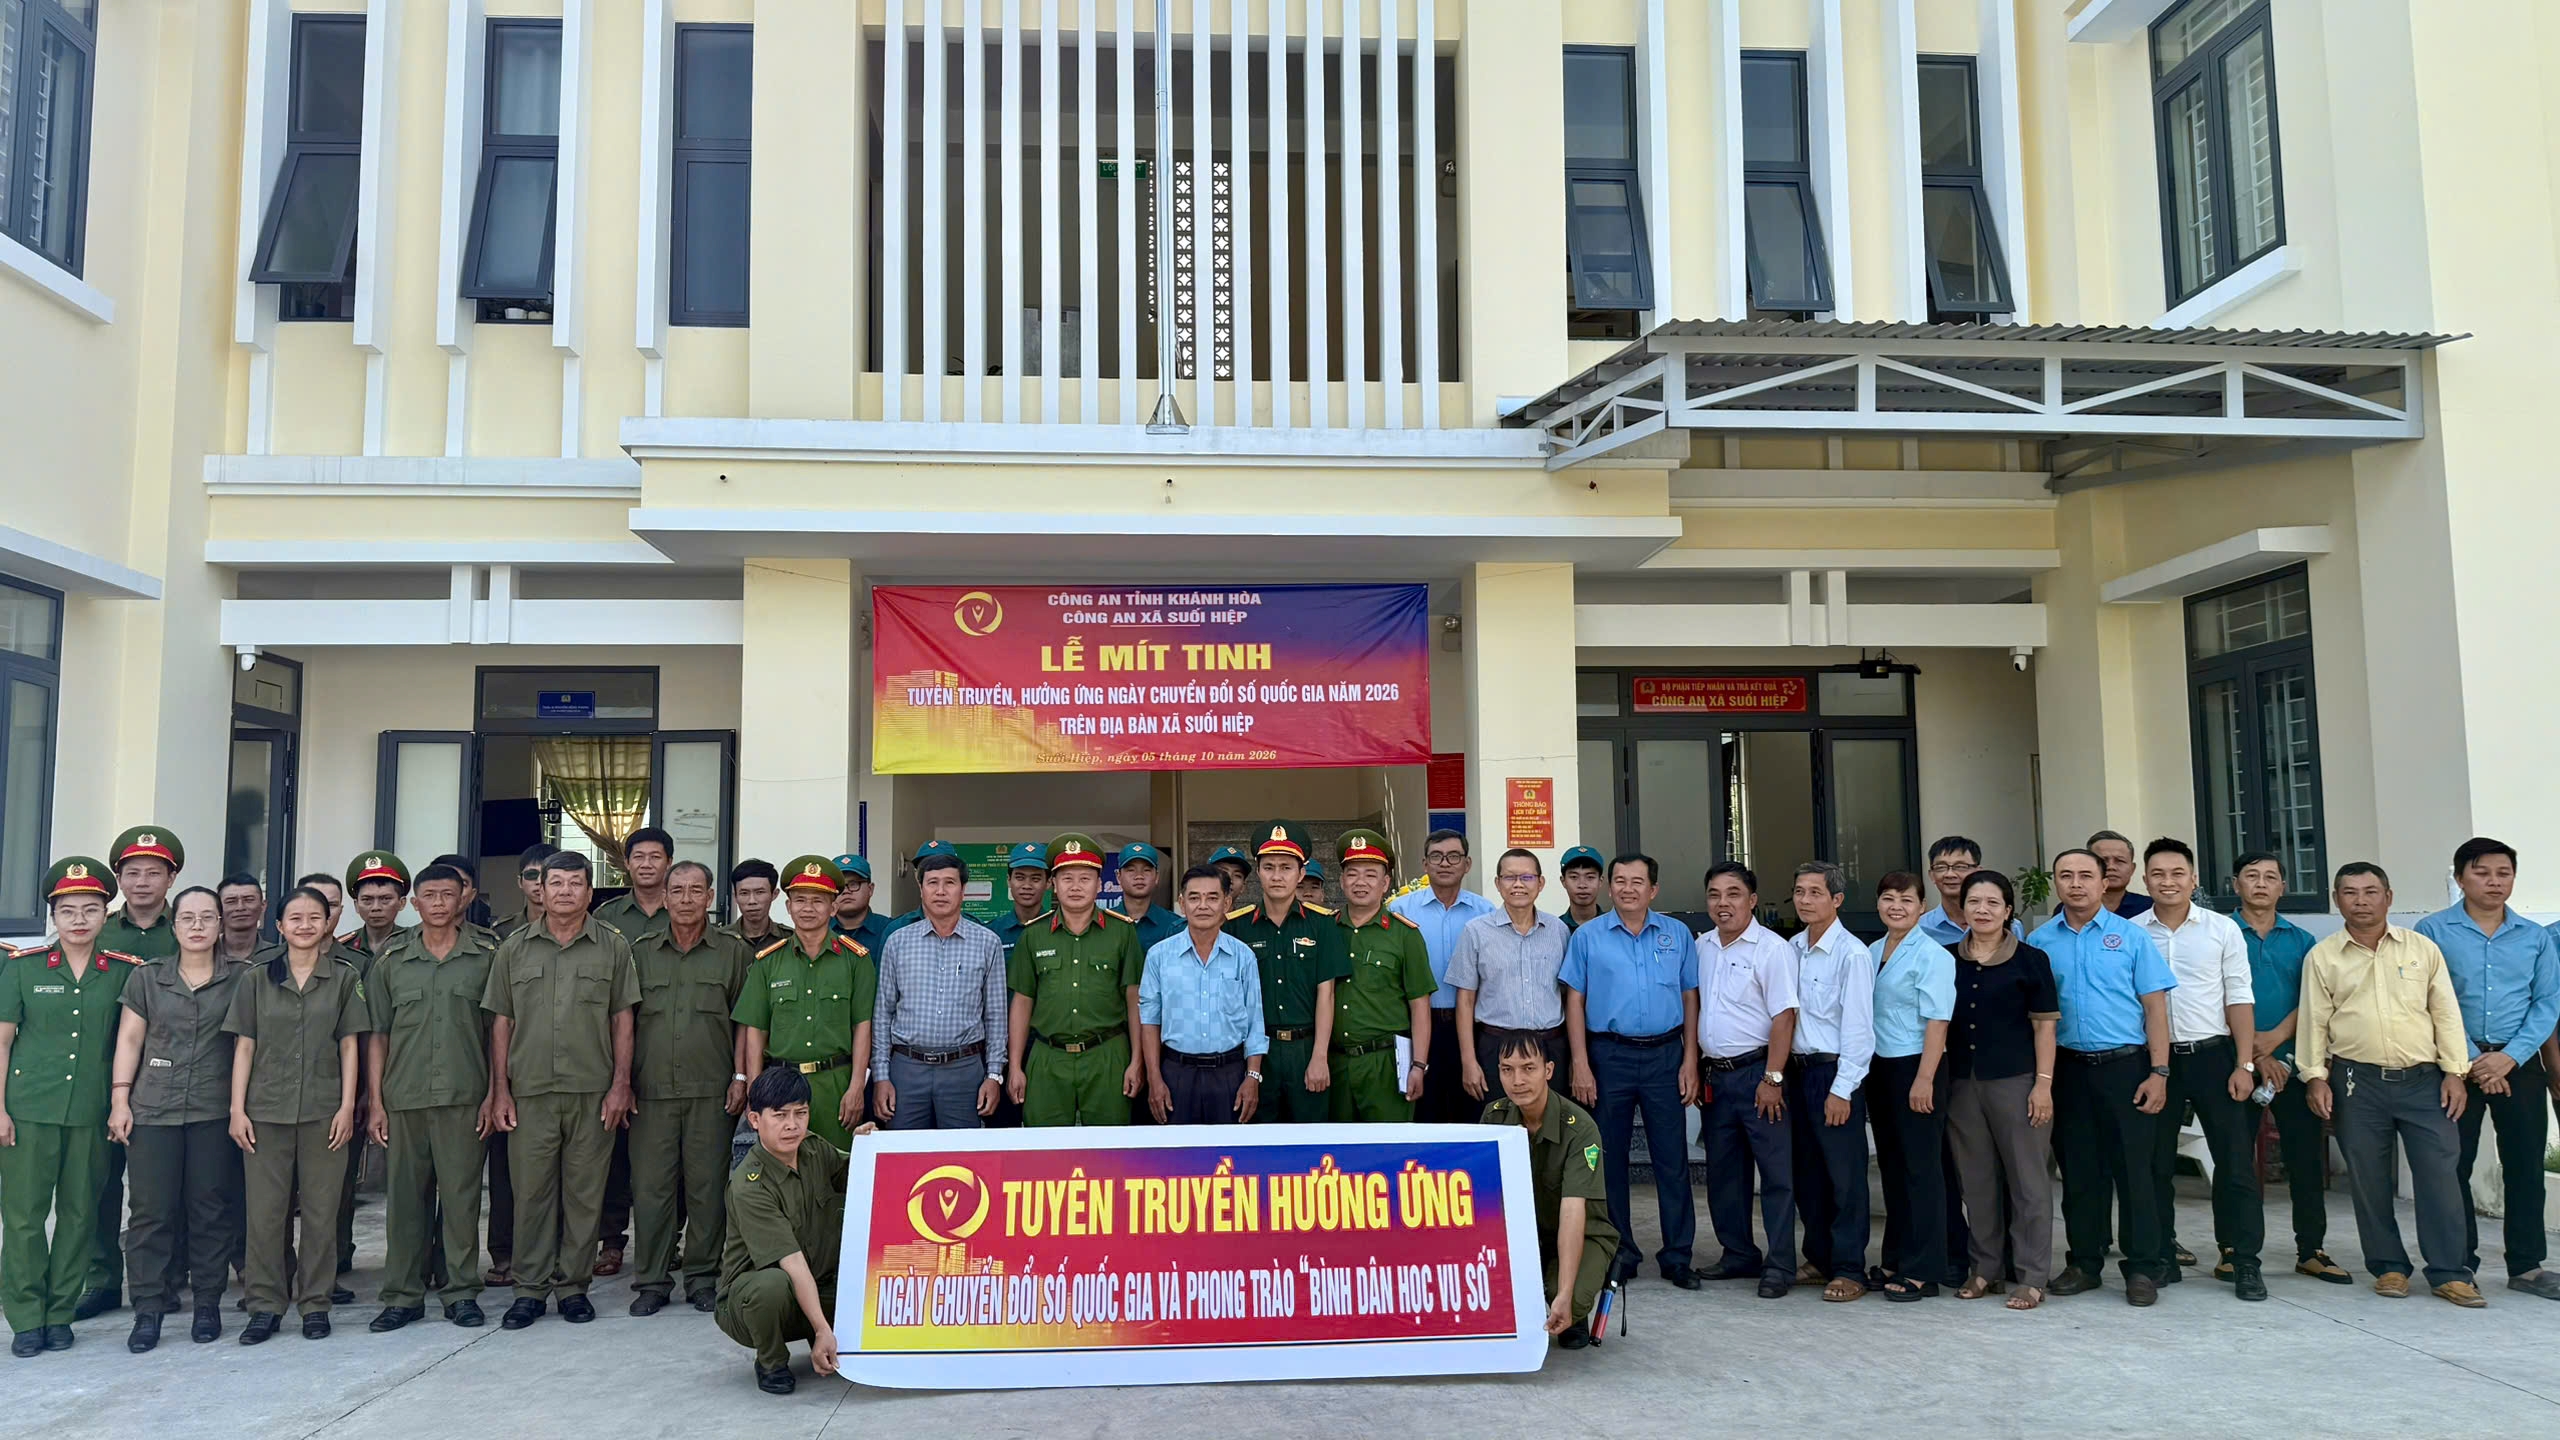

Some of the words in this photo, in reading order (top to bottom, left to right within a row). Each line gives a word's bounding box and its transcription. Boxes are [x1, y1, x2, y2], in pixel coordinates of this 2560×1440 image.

[1048, 592, 1095, 606] CÔNG
[1098, 594, 1121, 606] AN
[1125, 590, 1163, 605] TỈNH
[1168, 592, 1225, 605] KHÁNH
[1229, 590, 1262, 604] HÒA
[1063, 610, 1108, 624] CÔNG
[1113, 612, 1136, 624] AN
[1141, 610, 1163, 624] XÃ
[1168, 608, 1206, 624] SUỐI
[1211, 610, 1248, 625] HIỆP
[1041, 636, 1085, 672] LỄ
[1099, 639, 1170, 671] MÍT
[1182, 643, 1272, 671] TINH
[908, 684, 953, 706] TUYÊN
[958, 682, 1017, 707] TRUYỀN,
[1021, 682, 1070, 705] HƯỞNG
[1074, 684, 1104, 705] ỨNG
[1108, 682, 1146, 704] NGÀY
[1150, 679, 1206, 704] CHUYỂN
[1209, 678, 1234, 704] ĐỔI
[1237, 679, 1257, 704] SỐ
[1260, 678, 1298, 704] QUỐC
[1301, 684, 1325, 702] GIA
[1328, 681, 1361, 702] NĂM
[1365, 684, 1399, 701] 2026
[1652, 694, 1685, 706] CÔNG
[1688, 696, 1706, 706] AN
[1709, 694, 1726, 706] XÃ
[1729, 692, 1757, 706] SUỐI
[1761, 694, 1788, 709] HIỆP
[1060, 714, 1096, 734] TRÊN
[1100, 717, 1124, 738] ĐỊA
[1128, 712, 1158, 734] BÀN
[1162, 713, 1182, 734] XÃ
[1185, 710, 1218, 733] SUỐI
[1222, 712, 1254, 736] HIỆP
[1036, 751, 1068, 764] Suối
[1070, 750, 1103, 764] Hiệp,
[1107, 752, 1139, 764] ngày
[1142, 752, 1156, 762] 05
[1159, 752, 1196, 764] tháng
[1200, 752, 1214, 762] 10
[1218, 752, 1246, 762] năm
[1248, 750, 1277, 761] 2026
[1002, 1167, 1114, 1238] TUYÊN
[1124, 1156, 1259, 1234] TRUYỀN
[1269, 1154, 1390, 1231] HƯỞNG
[1398, 1160, 1474, 1229] ỨNG
[876, 1264, 928, 1326] NGÀY
[931, 1255, 1004, 1326] CHUYỂN
[1007, 1254, 1038, 1325] ĐỔI
[1042, 1256, 1068, 1324] SỐ
[1072, 1255, 1119, 1329] QUỐC
[1124, 1272, 1154, 1321] GIA
[1158, 1261, 1181, 1320] VÀ
[1186, 1270, 1246, 1320] PHONG
[1250, 1258, 1294, 1318] TRÀO
[1356, 1256, 1394, 1314] DÂN
[1397, 1264, 1434, 1324] HỌC
[1436, 1263, 1462, 1323] VỤ
